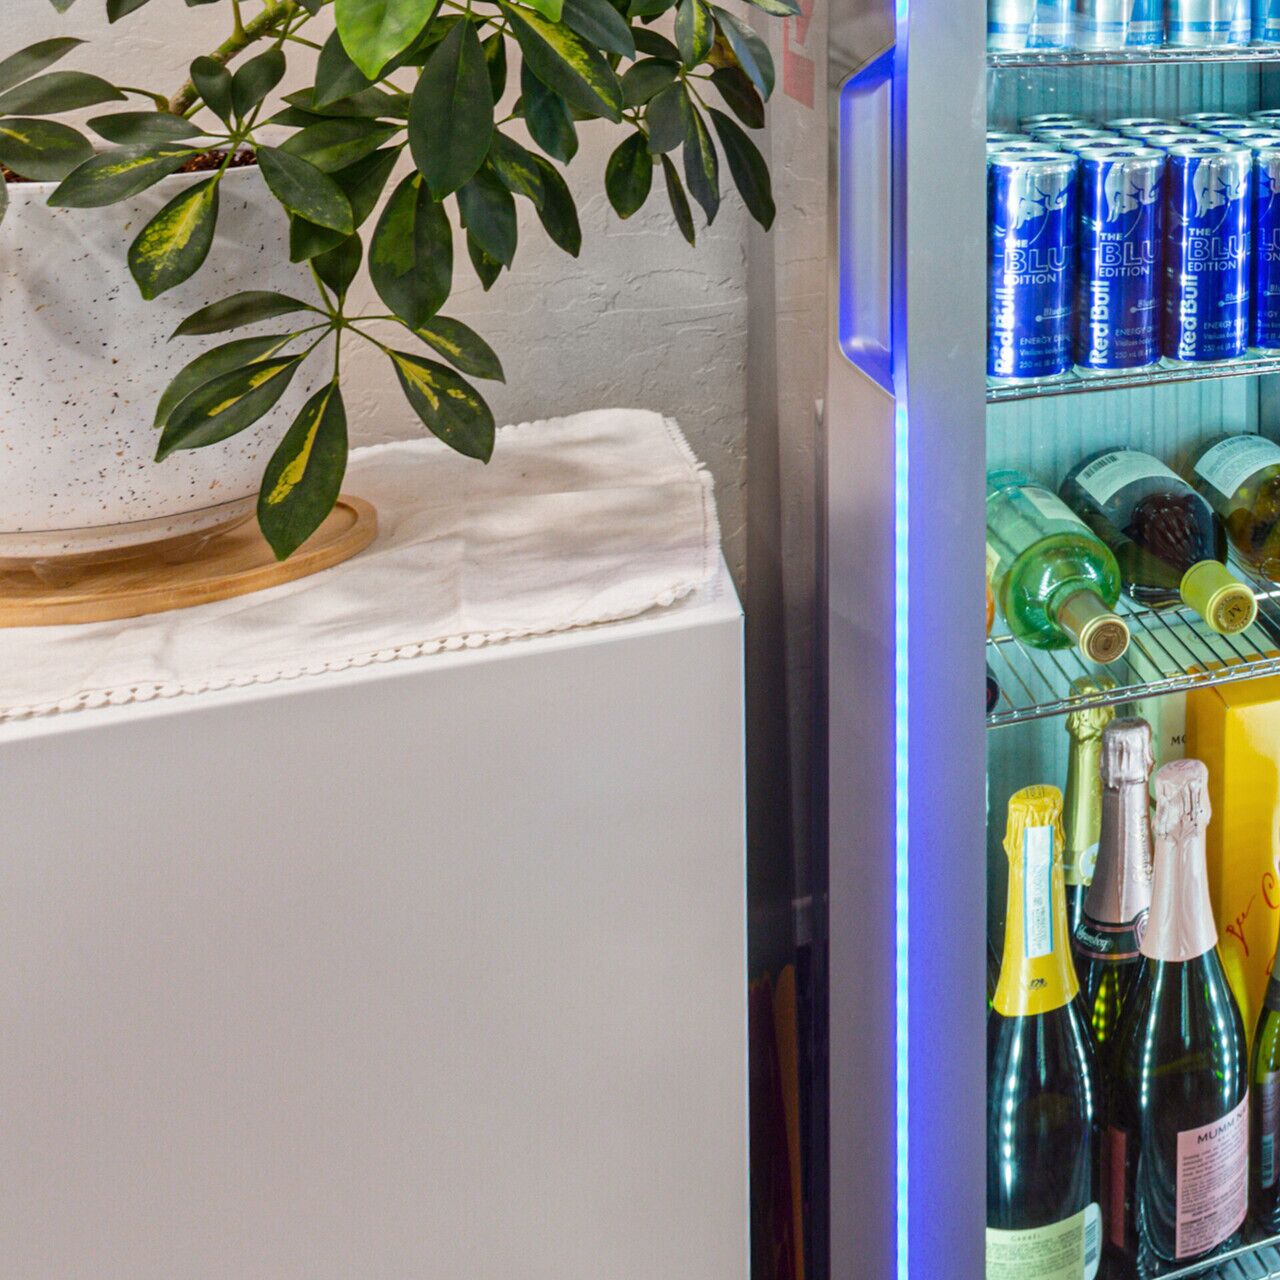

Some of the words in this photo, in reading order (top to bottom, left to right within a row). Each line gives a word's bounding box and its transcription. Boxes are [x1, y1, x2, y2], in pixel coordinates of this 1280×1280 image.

[1100, 232, 1122, 241] THE
[1188, 228, 1211, 236] THE
[1099, 266, 1149, 277] EDITION
[1188, 260, 1237, 271] EDITION
[1090, 281, 1110, 321] Bull
[1180, 274, 1198, 314] Bull
[1089, 324, 1109, 364] Red
[1178, 317, 1197, 358] Red
[1197, 1120, 1235, 1145] MUMM
